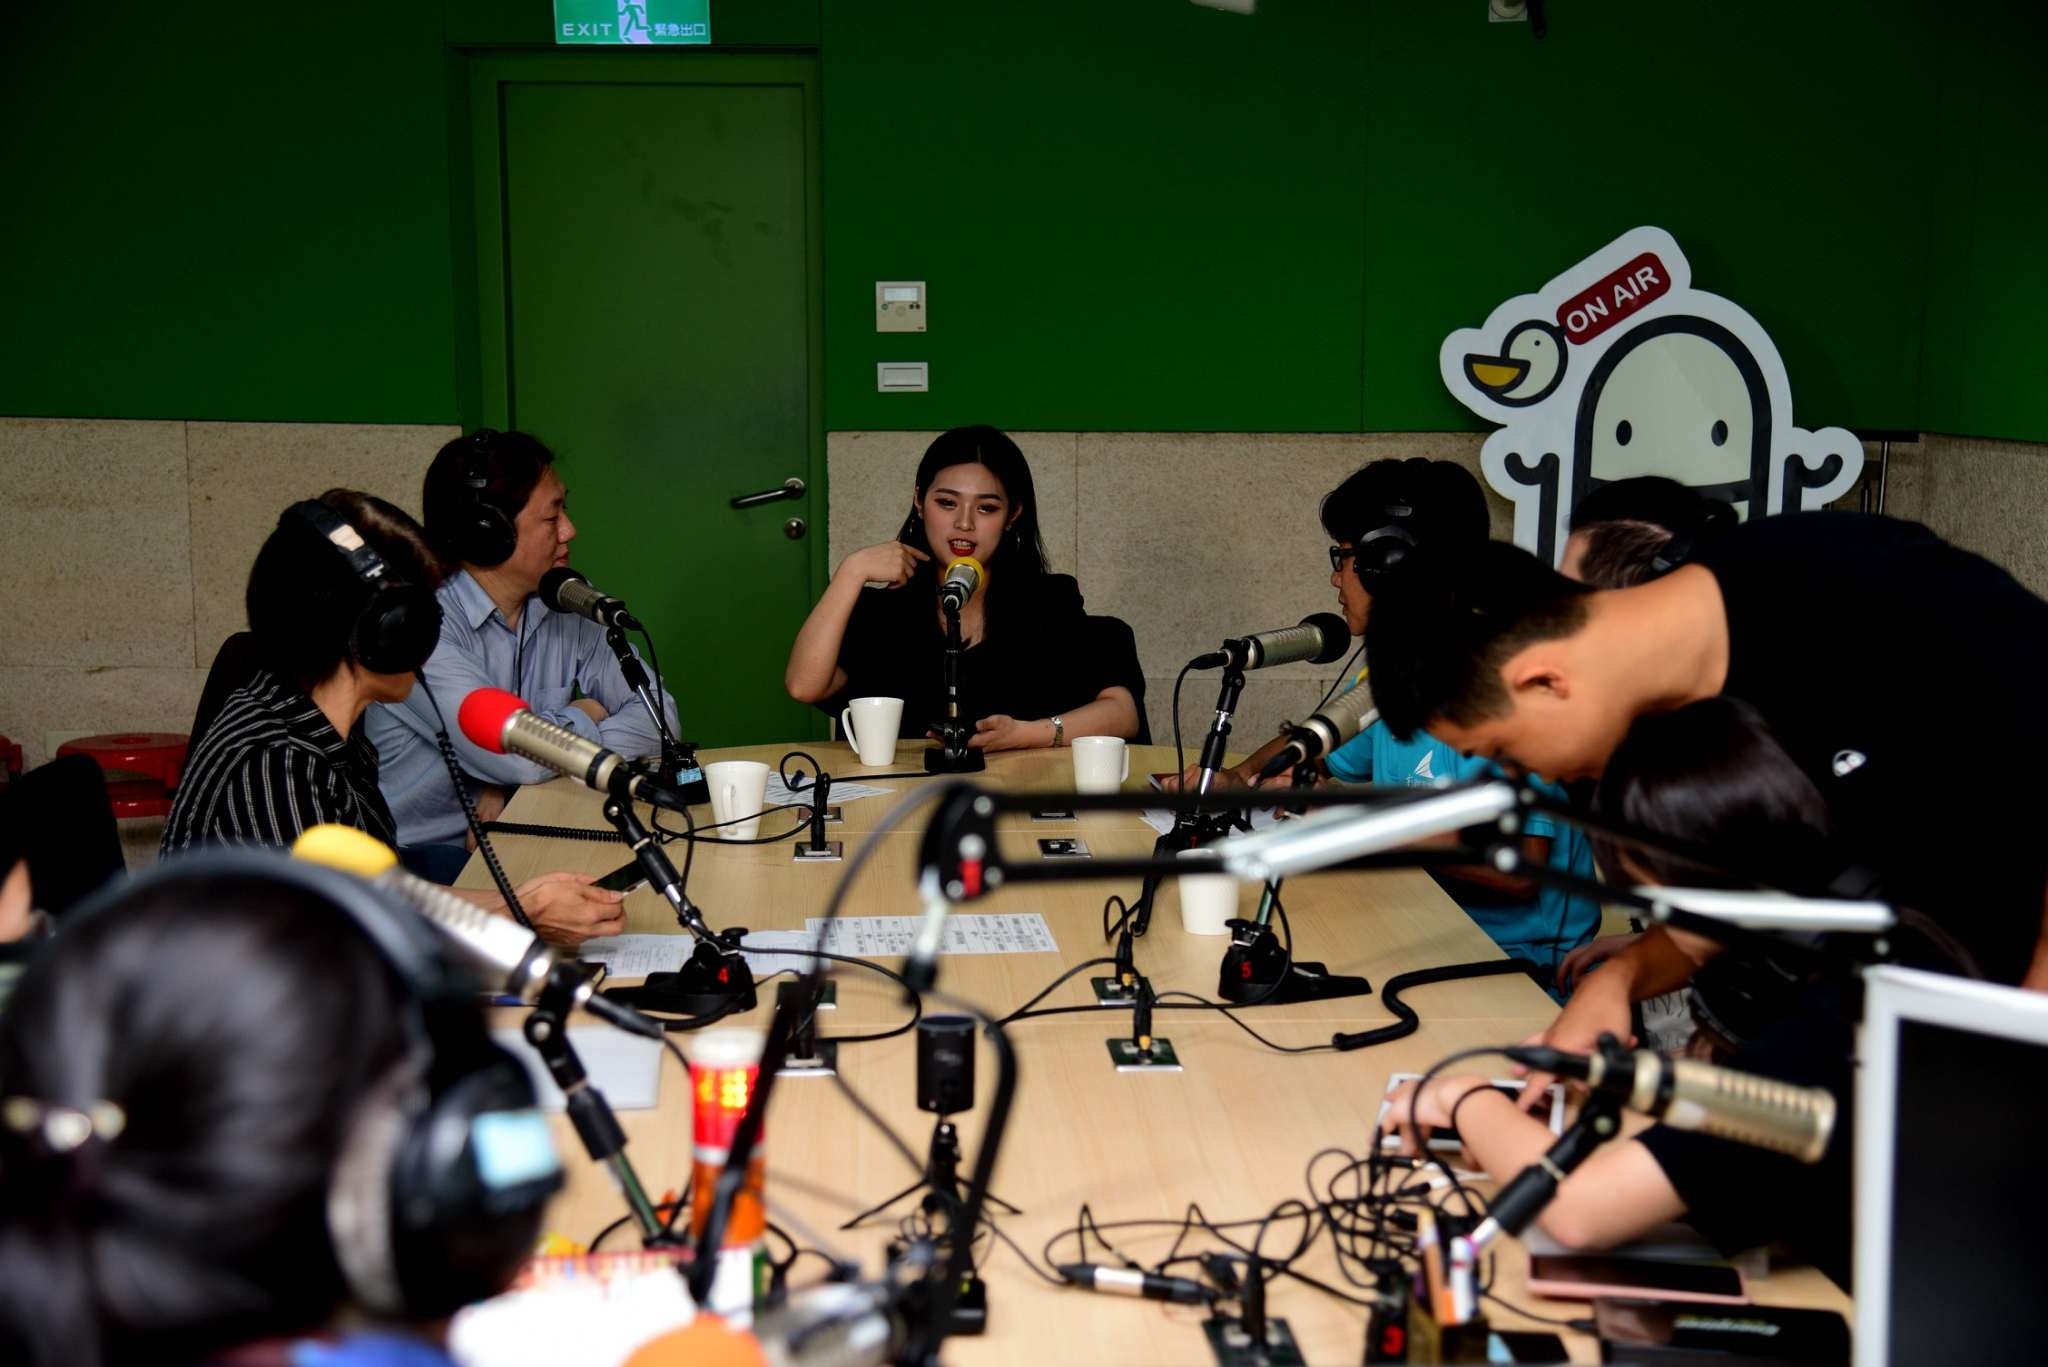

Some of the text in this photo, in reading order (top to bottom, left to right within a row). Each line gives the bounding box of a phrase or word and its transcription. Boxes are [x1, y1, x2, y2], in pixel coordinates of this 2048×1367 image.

[562, 23, 613, 36] EXIT
[654, 23, 706, 37] 緊急出口
[1566, 265, 1660, 333] ON AIR
[1240, 960, 1253, 981] 5
